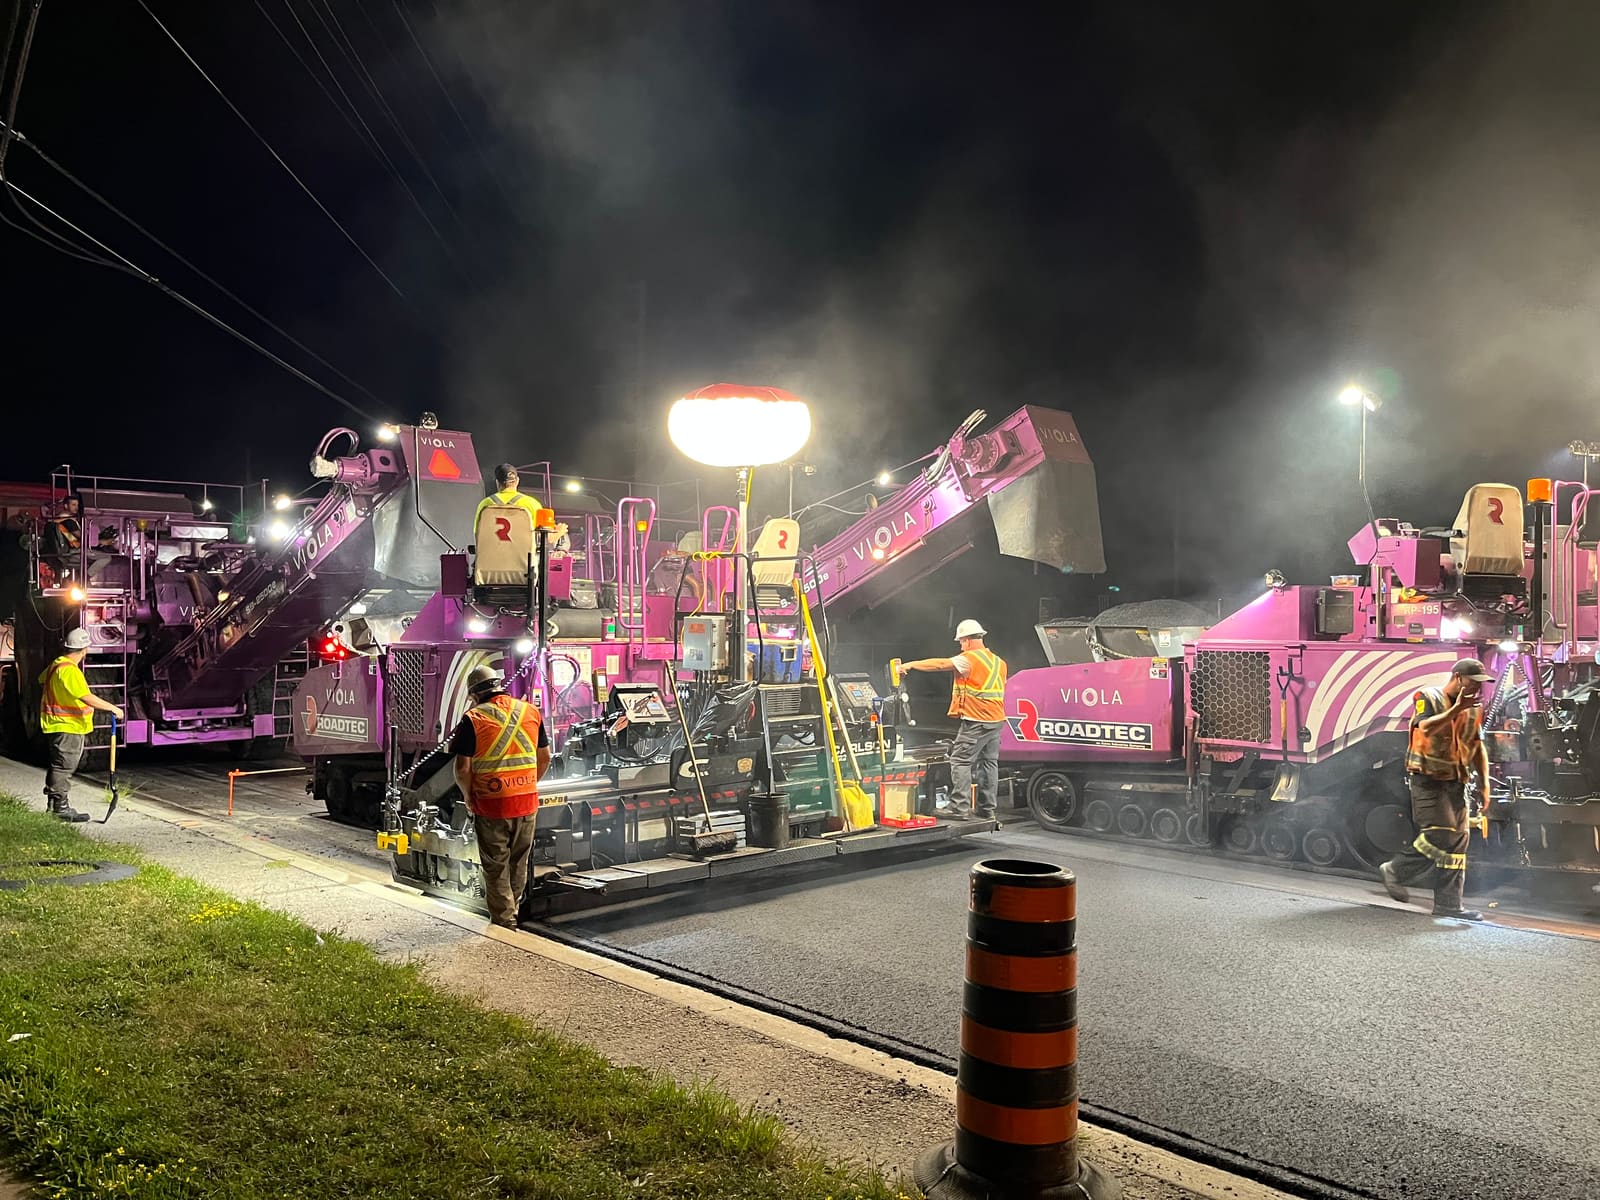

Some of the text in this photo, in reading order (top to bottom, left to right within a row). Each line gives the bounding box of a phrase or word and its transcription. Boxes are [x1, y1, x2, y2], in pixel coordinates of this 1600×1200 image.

[420, 436, 456, 449] VIOLA
[1039, 426, 1078, 444] VIOLA
[852, 511, 917, 561] VIOLA
[292, 523, 334, 570] VIOLA
[1404, 604, 1439, 615] RP-195
[325, 688, 355, 706] VIOLA
[1060, 687, 1123, 707] VIOLA
[317, 716, 366, 734] ROADTEC
[1040, 721, 1146, 741] ROADTEC
[503, 774, 536, 788] VIOLA
